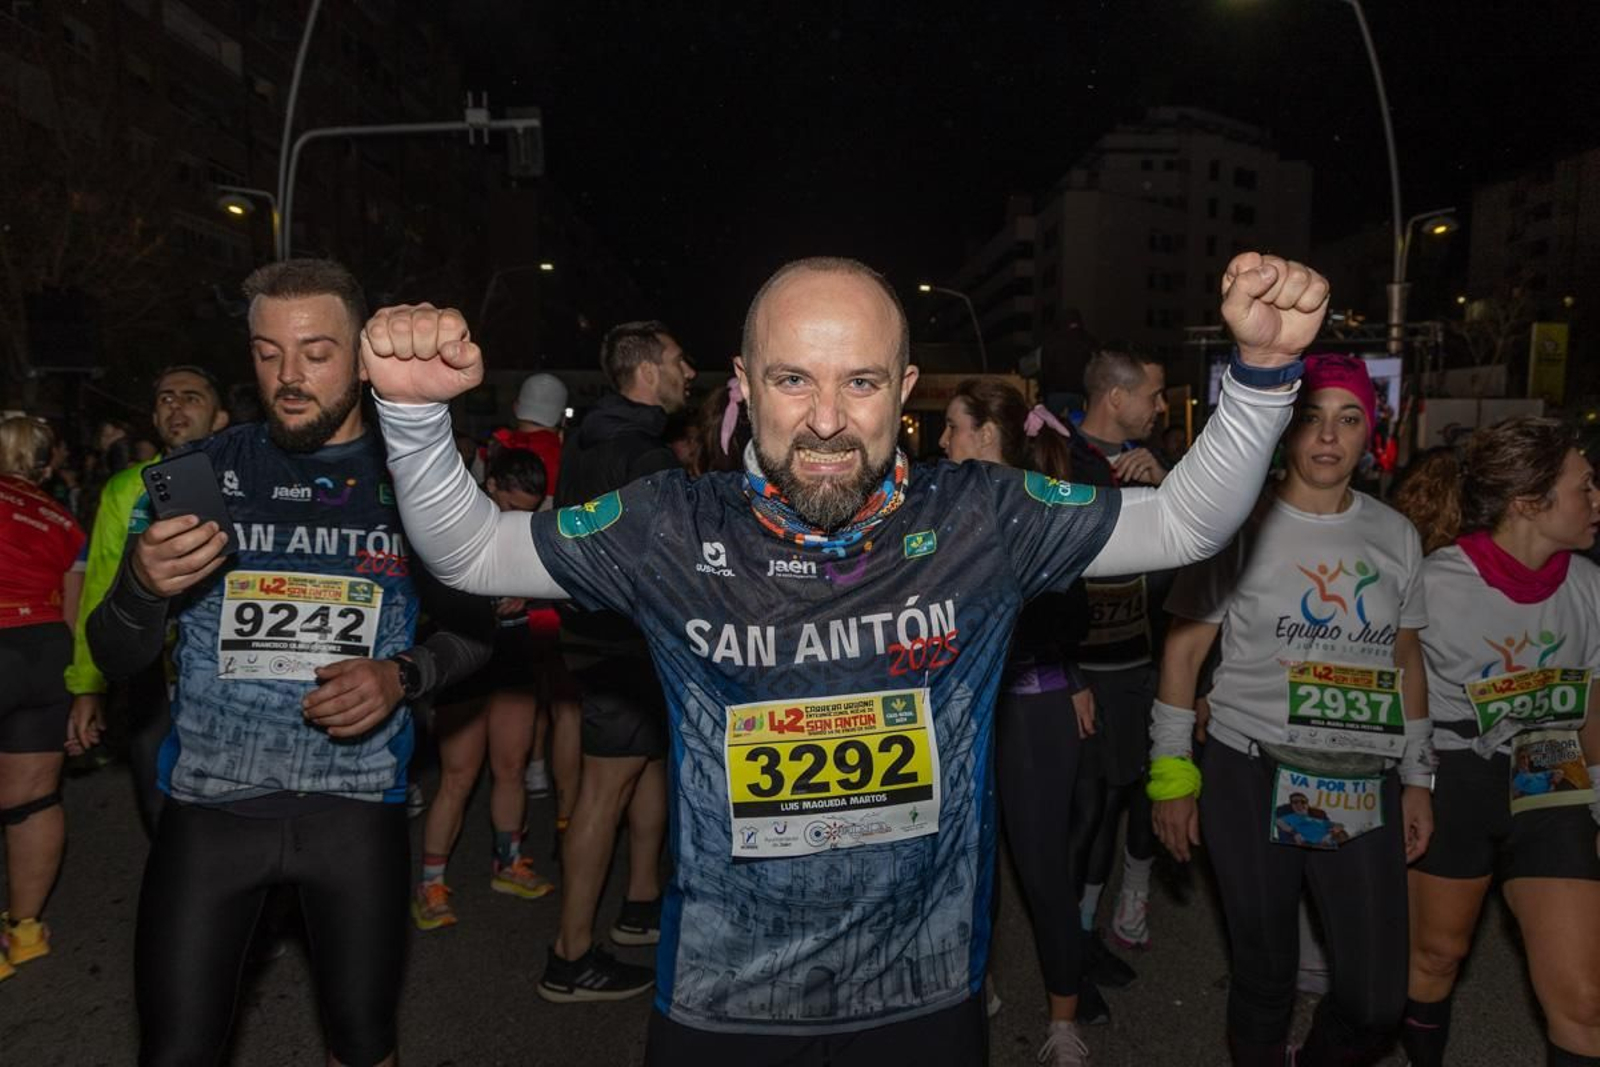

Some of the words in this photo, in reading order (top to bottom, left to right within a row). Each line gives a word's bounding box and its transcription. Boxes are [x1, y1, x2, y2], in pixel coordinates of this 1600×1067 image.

[259, 577, 288, 595] 42
[234, 602, 365, 643] 9242
[684, 618, 776, 668] SAN
[794, 595, 955, 664] ANTÓN
[1275, 615, 1342, 646] Equipo
[888, 628, 960, 676] 2025
[1312, 665, 1334, 681] 42
[1492, 678, 1517, 694] 42
[1297, 685, 1393, 723] 2937
[1488, 686, 1576, 726] 2950
[768, 708, 805, 734] 42
[806, 719, 832, 732] SAN
[835, 714, 876, 728] ANTON
[745, 735, 918, 798] 3292
[1290, 773, 1309, 788] VA
[1316, 780, 1346, 792] POR
[1352, 782, 1366, 793] TI
[780, 802, 800, 812] LUIS
[802, 797, 848, 810] MAQUEDA
[850, 793, 888, 805] MARTOS
[1314, 790, 1376, 811] JULIO
